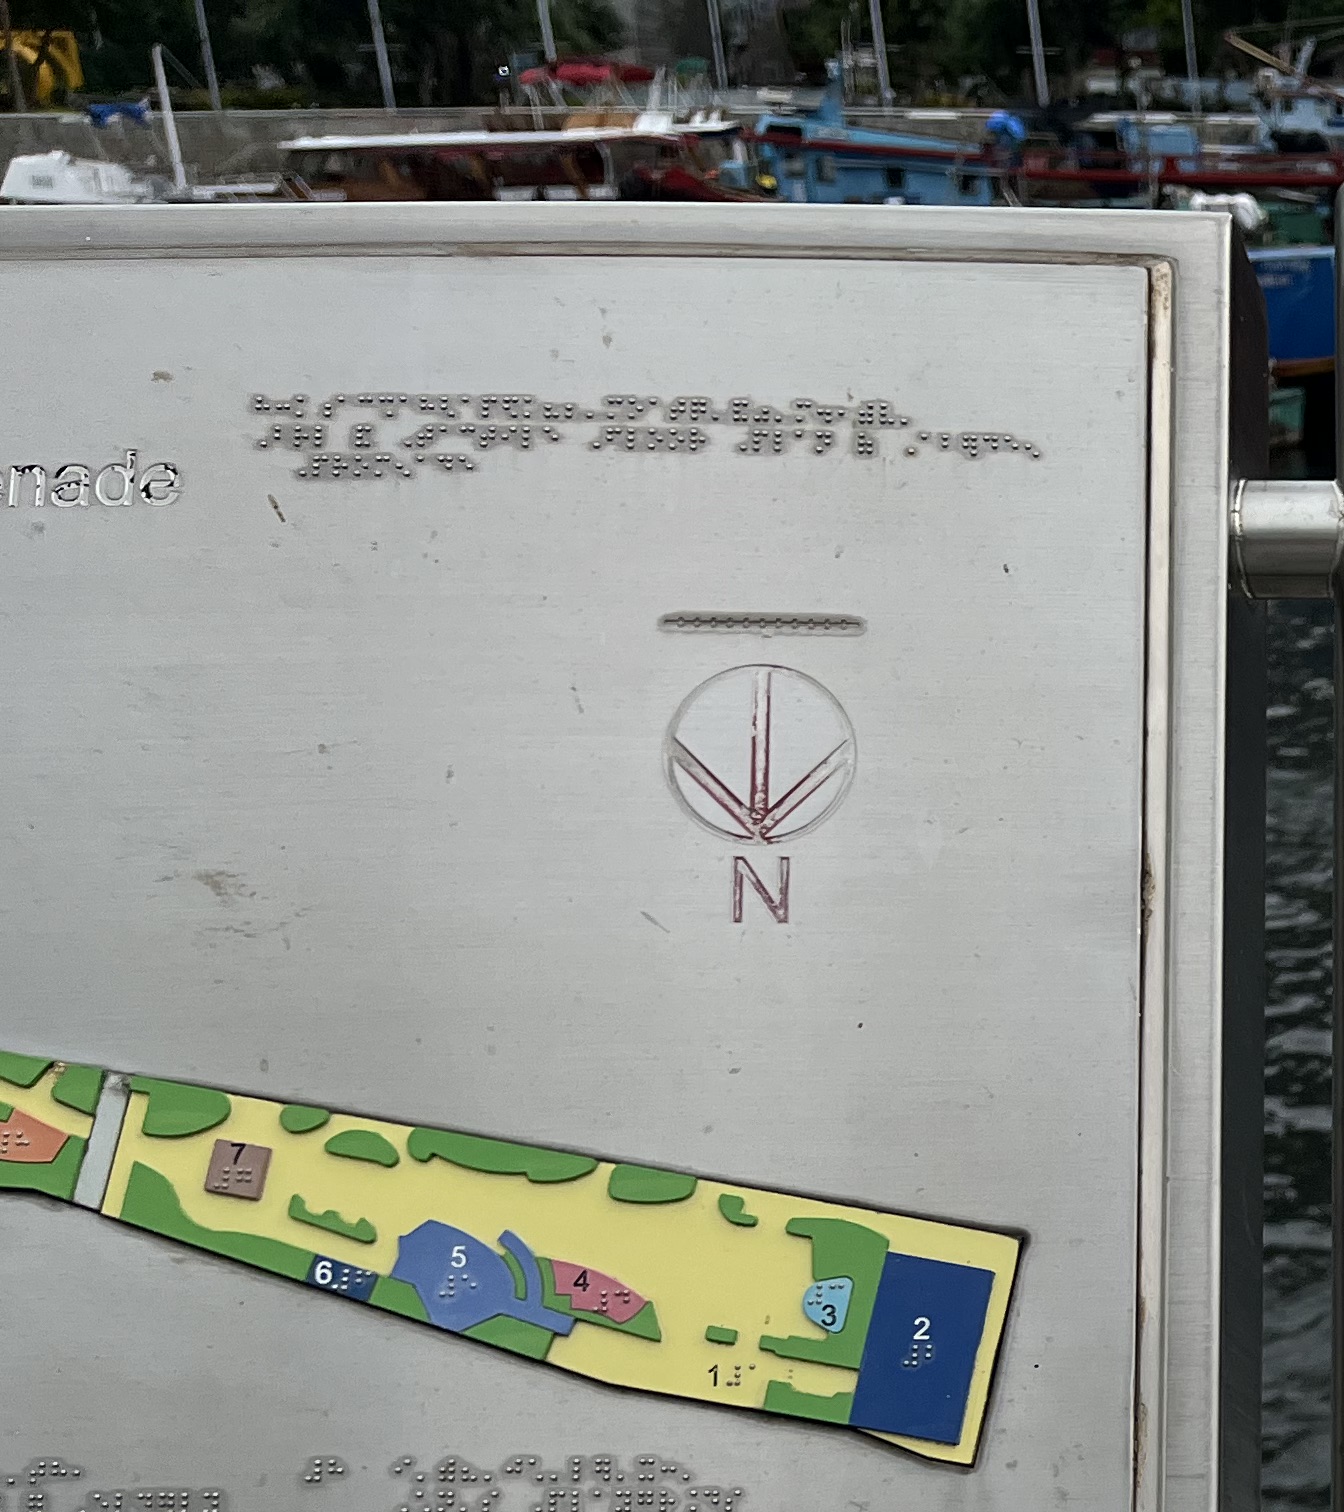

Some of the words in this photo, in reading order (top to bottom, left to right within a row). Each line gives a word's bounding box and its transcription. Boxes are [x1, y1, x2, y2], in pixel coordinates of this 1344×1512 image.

[0, 448, 185, 508] nade
[732, 855, 790, 923] N
[229, 1142, 247, 1166] 7
[450, 1245, 467, 1268] 5
[314, 1260, 333, 1285] 6
[572, 1269, 590, 1292] 4
[820, 1303, 838, 1327] 3
[912, 1316, 931, 1340] 2
[707, 1364, 719, 1387] 1
